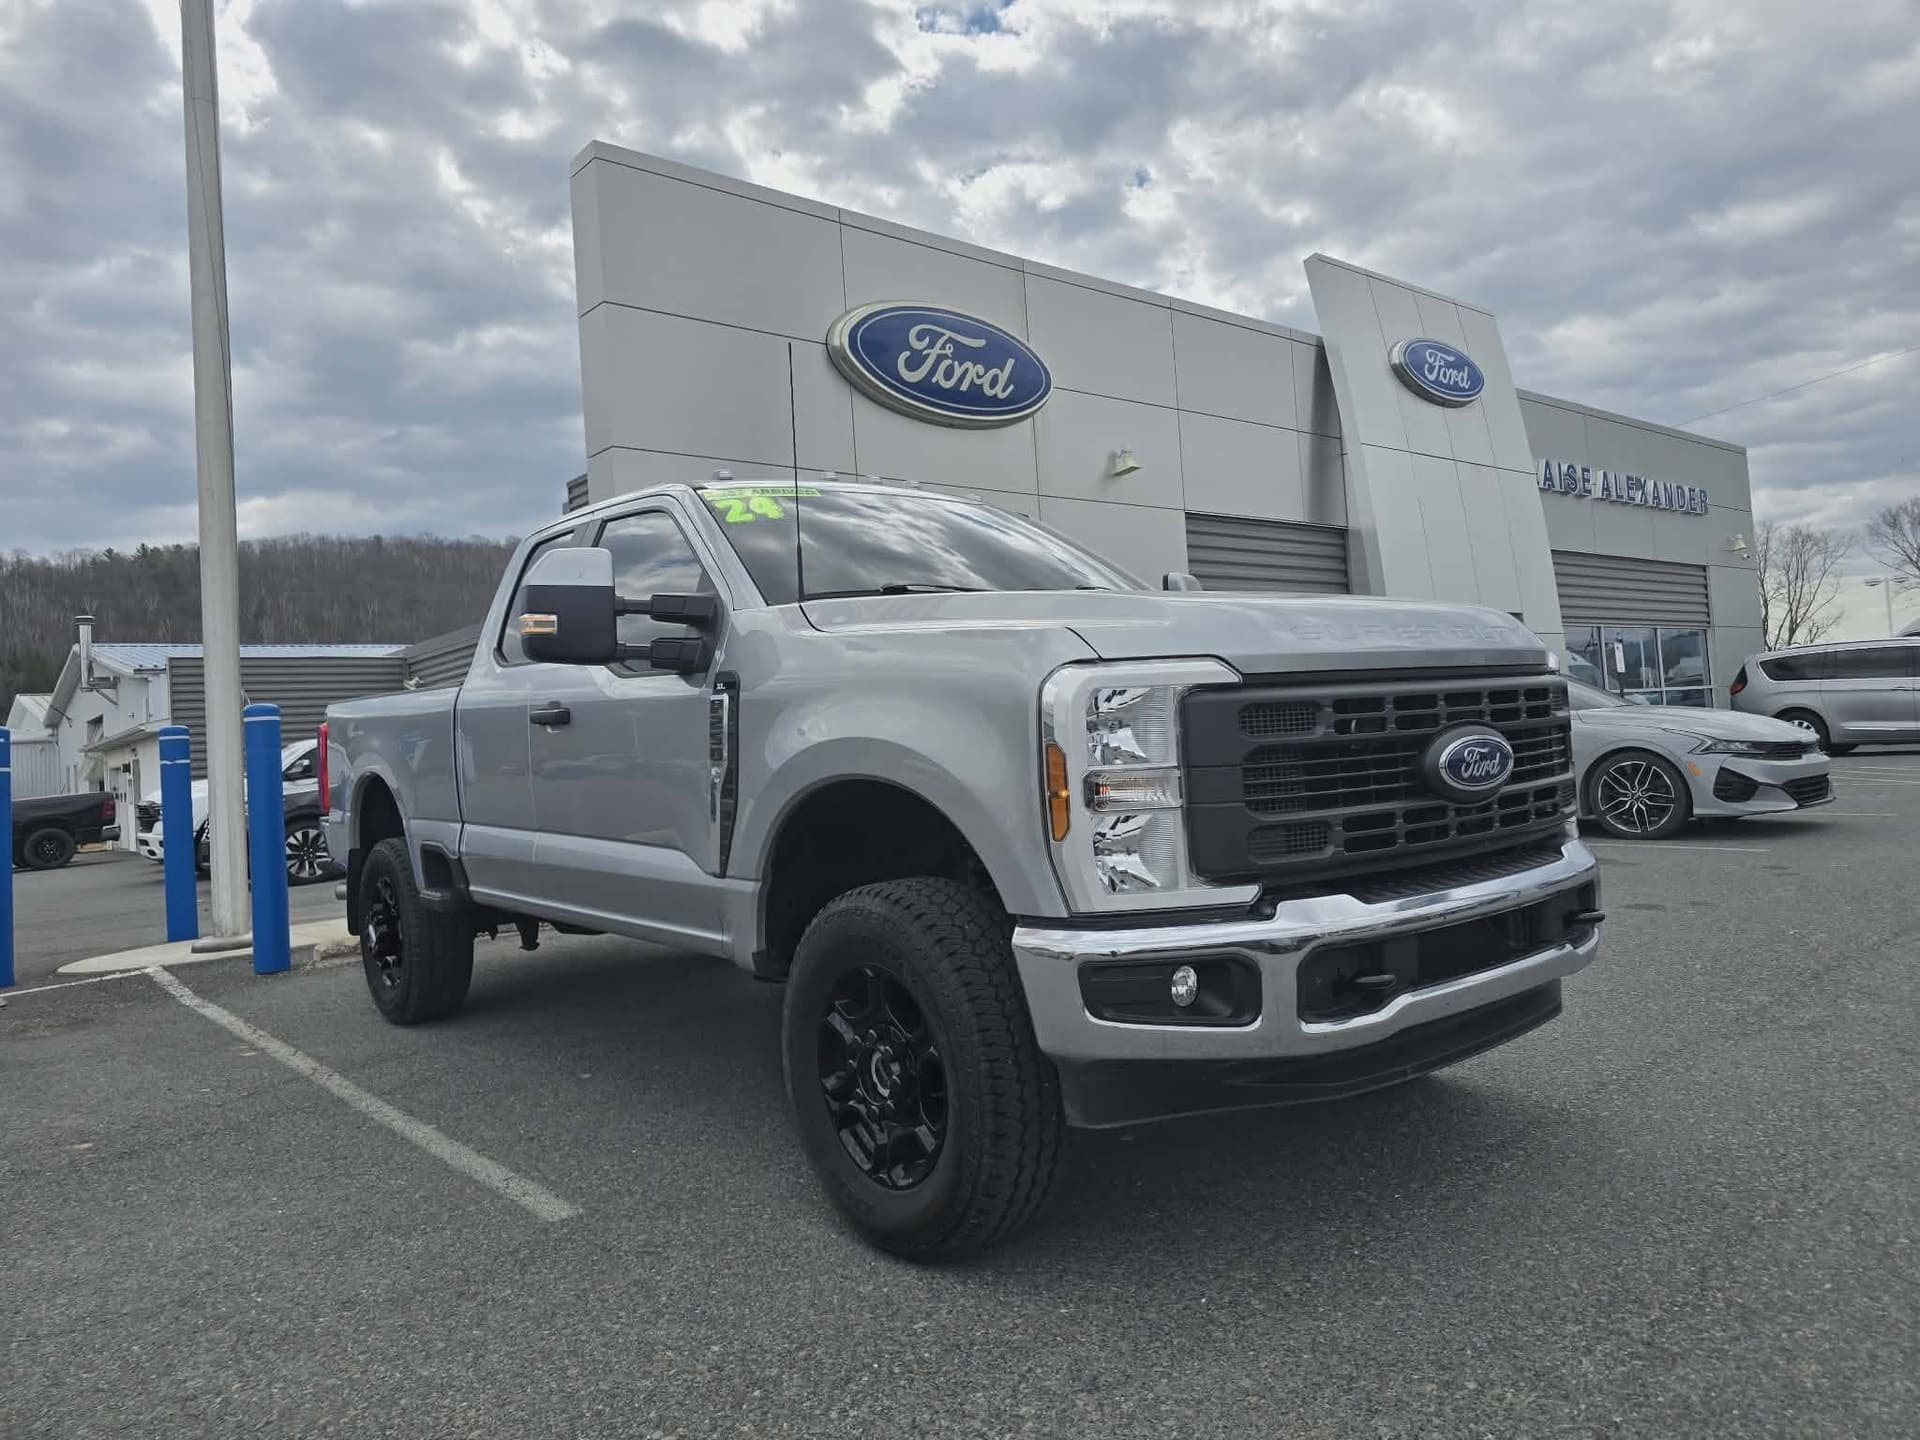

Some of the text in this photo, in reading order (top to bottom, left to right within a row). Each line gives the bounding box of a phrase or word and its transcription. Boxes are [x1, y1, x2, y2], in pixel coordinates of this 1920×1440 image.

[897, 323, 1015, 400] Ford
[1424, 349, 1471, 389] Ford
[1599, 470, 1709, 514] ALEXANDER
[1461, 746, 1500, 778] Ford
